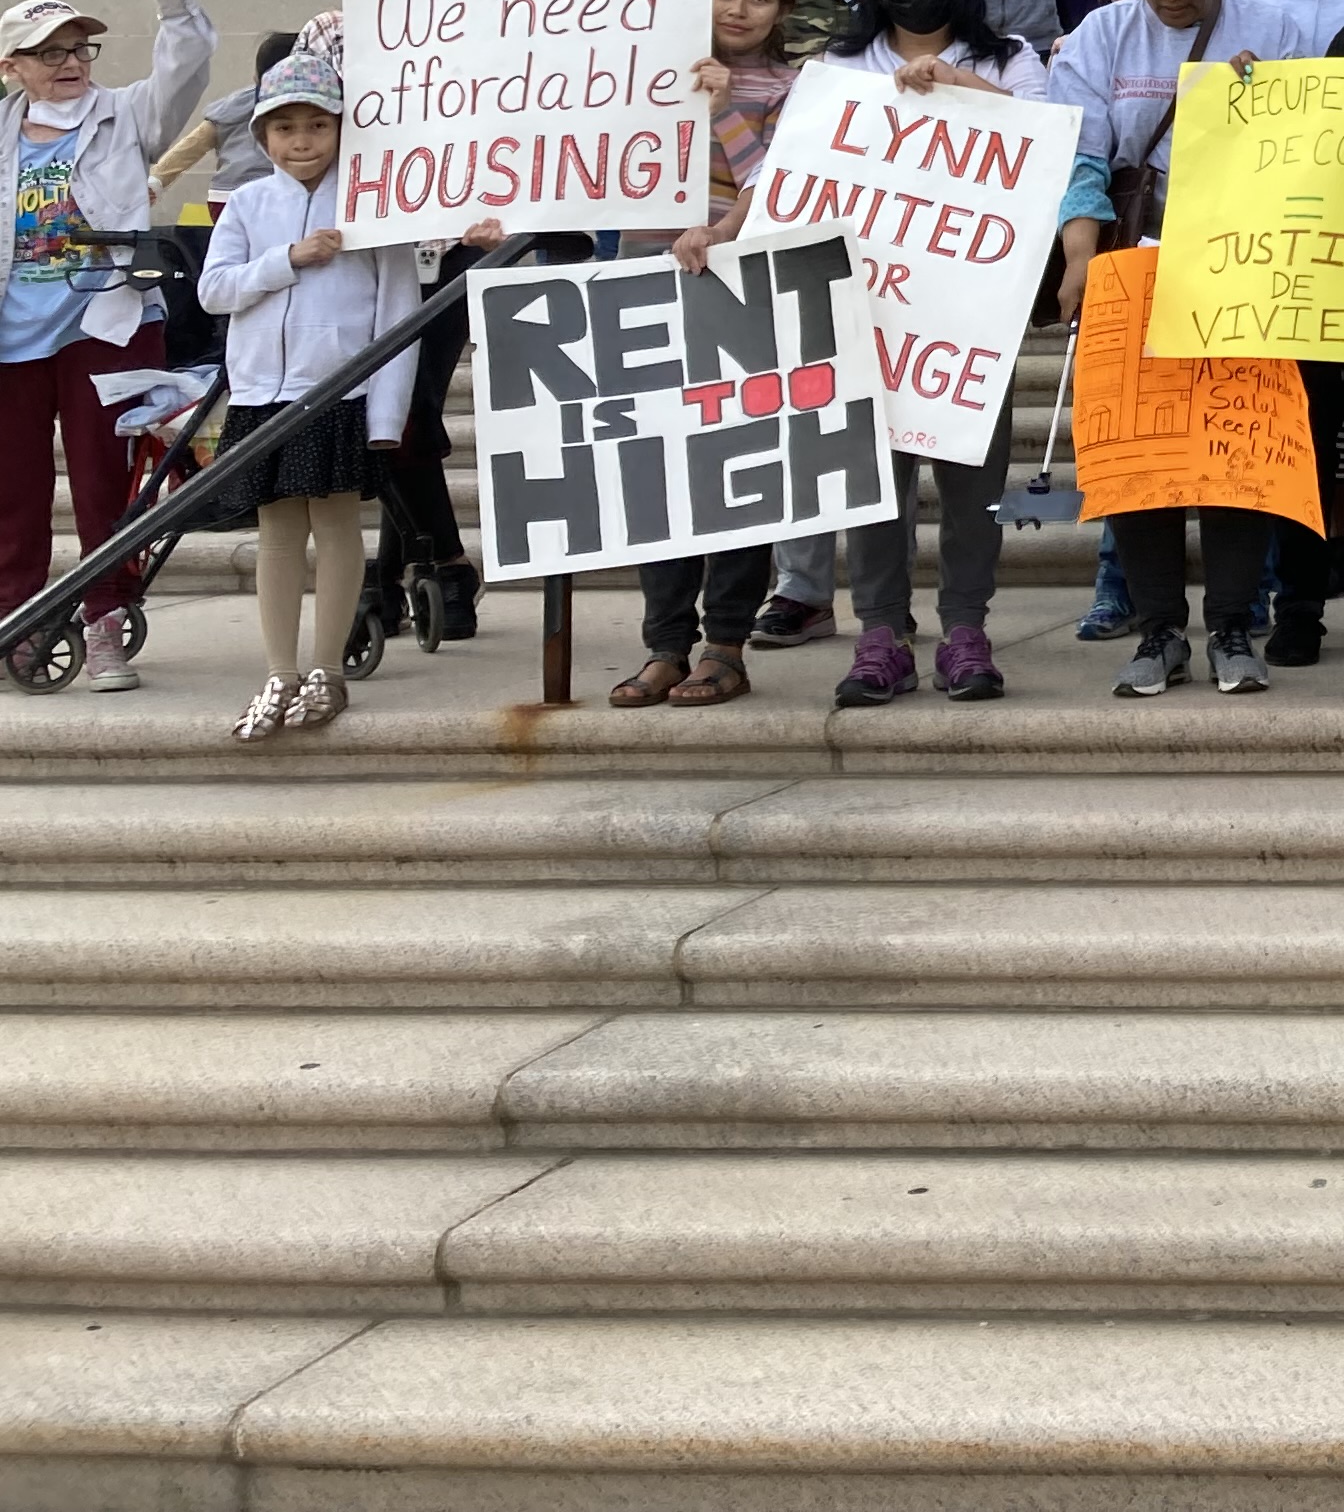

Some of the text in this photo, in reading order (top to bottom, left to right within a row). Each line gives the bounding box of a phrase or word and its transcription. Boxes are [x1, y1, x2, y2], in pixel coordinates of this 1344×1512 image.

[352, 44, 685, 129] affordable
[344, 120, 696, 223] HOUSING!
[830, 99, 1034, 190] LYNN
[1254, 134, 1303, 174] DE
[765, 167, 1017, 264] UNITED
[481, 235, 854, 412] RENT
[1270, 272, 1315, 302] DE
[560, 362, 837, 445] IS TOO
[1204, 412, 1261, 440] Keep
[1208, 385, 1279, 418] Salud
[491, 397, 882, 567] HIGH
[1209, 439, 1230, 457] IN
